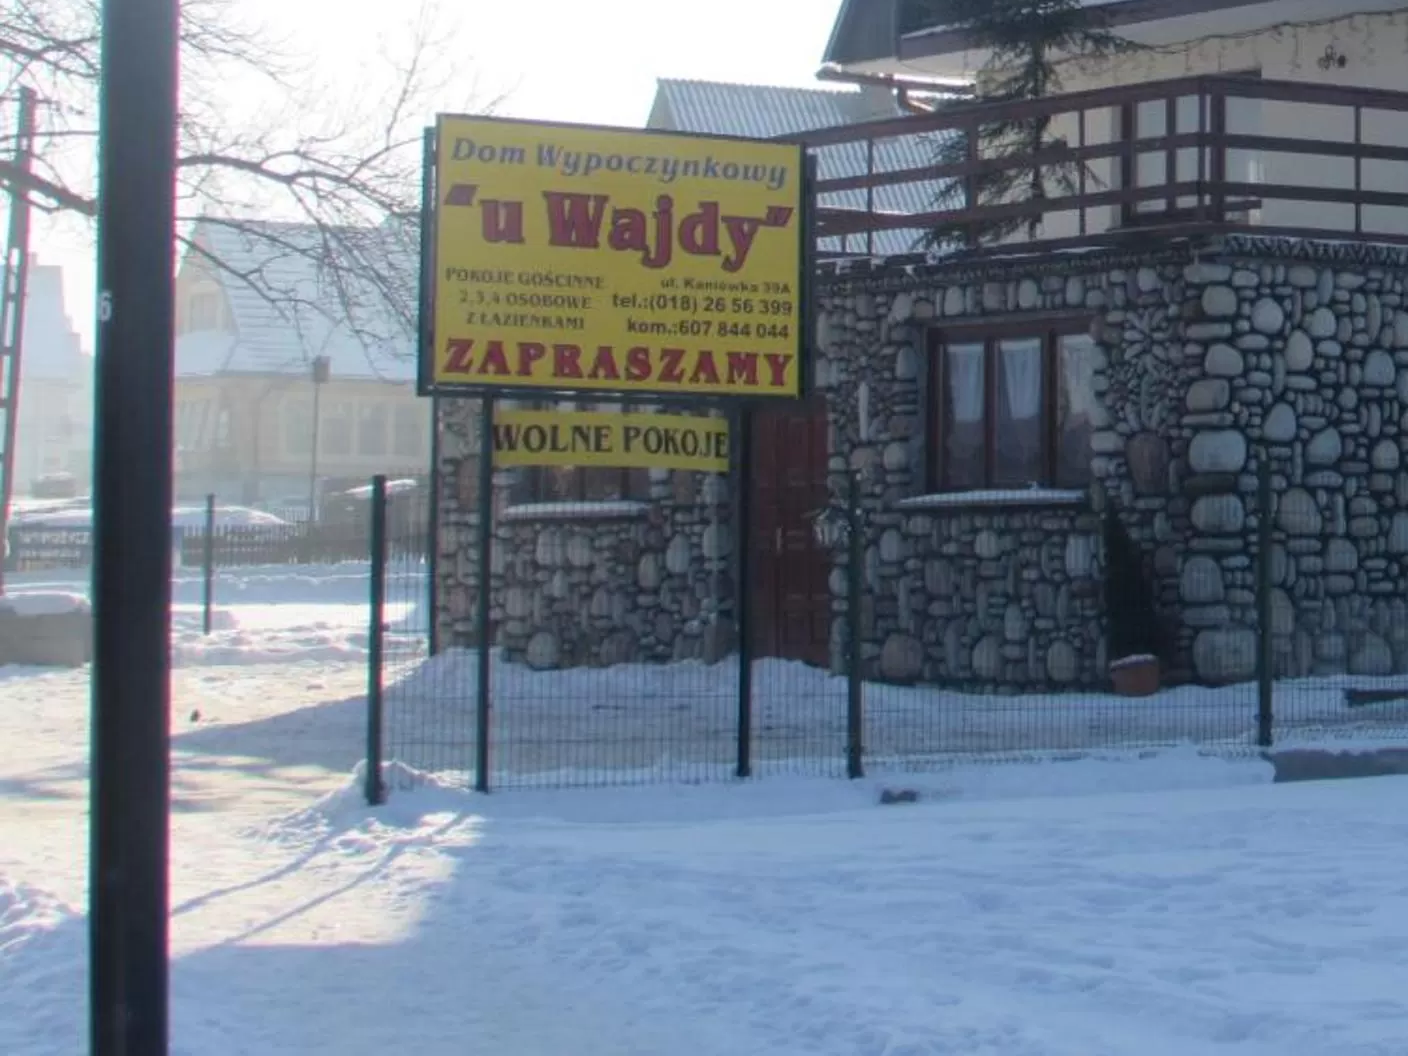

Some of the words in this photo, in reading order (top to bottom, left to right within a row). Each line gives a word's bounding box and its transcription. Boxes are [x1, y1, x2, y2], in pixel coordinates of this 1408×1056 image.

[452, 137, 525, 165] Dom
[536, 143, 787, 190] Wypoczynkowy
[505, 292, 593, 310] OSOBOWE
[703, 296, 726, 313] 26
[731, 298, 753, 314] 56
[758, 299, 793, 316] 399
[717, 321, 751, 337] 844
[755, 323, 790, 340] 044
[443, 338, 793, 387] ZAPRASZAMY
[492, 423, 613, 454] WOLNE
[622, 425, 729, 459] POKOJE
